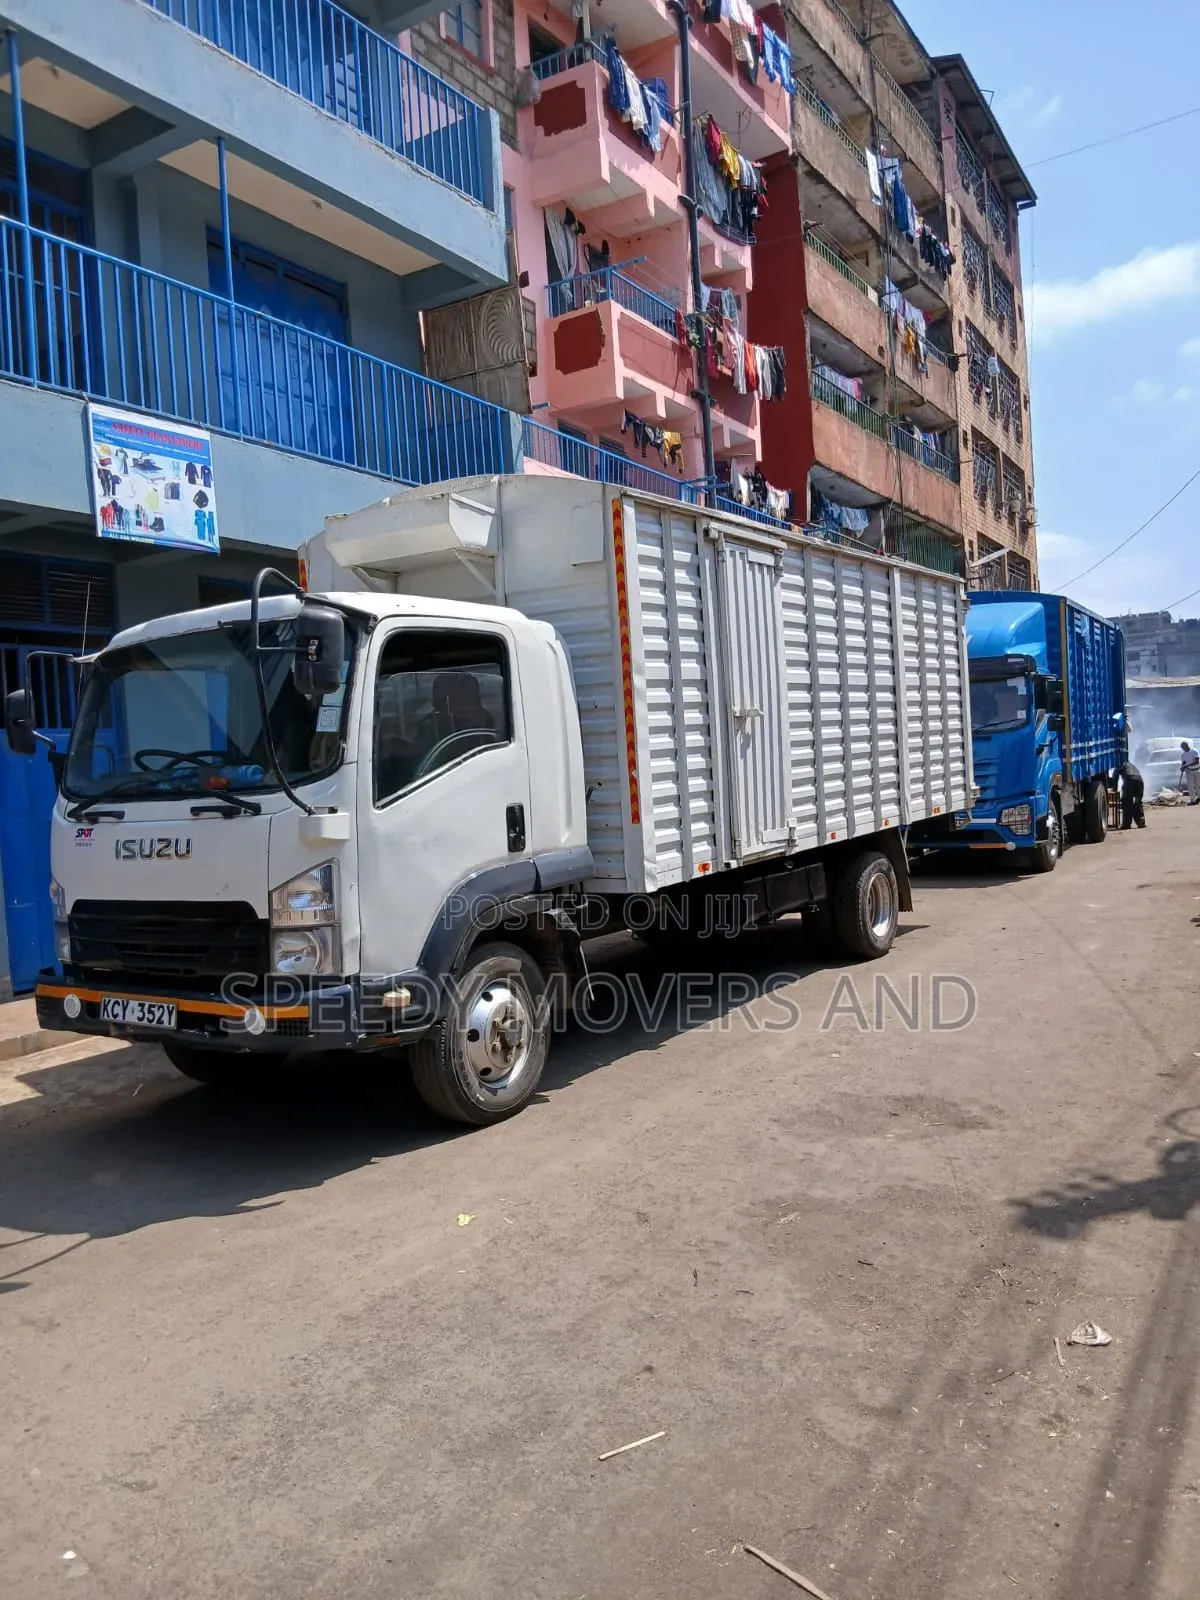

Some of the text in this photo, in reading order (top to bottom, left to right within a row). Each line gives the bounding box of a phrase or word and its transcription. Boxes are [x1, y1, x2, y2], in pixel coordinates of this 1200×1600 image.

[115, 838, 191, 860] ISUZU
[102, 999, 175, 1026] KCY 352Y
